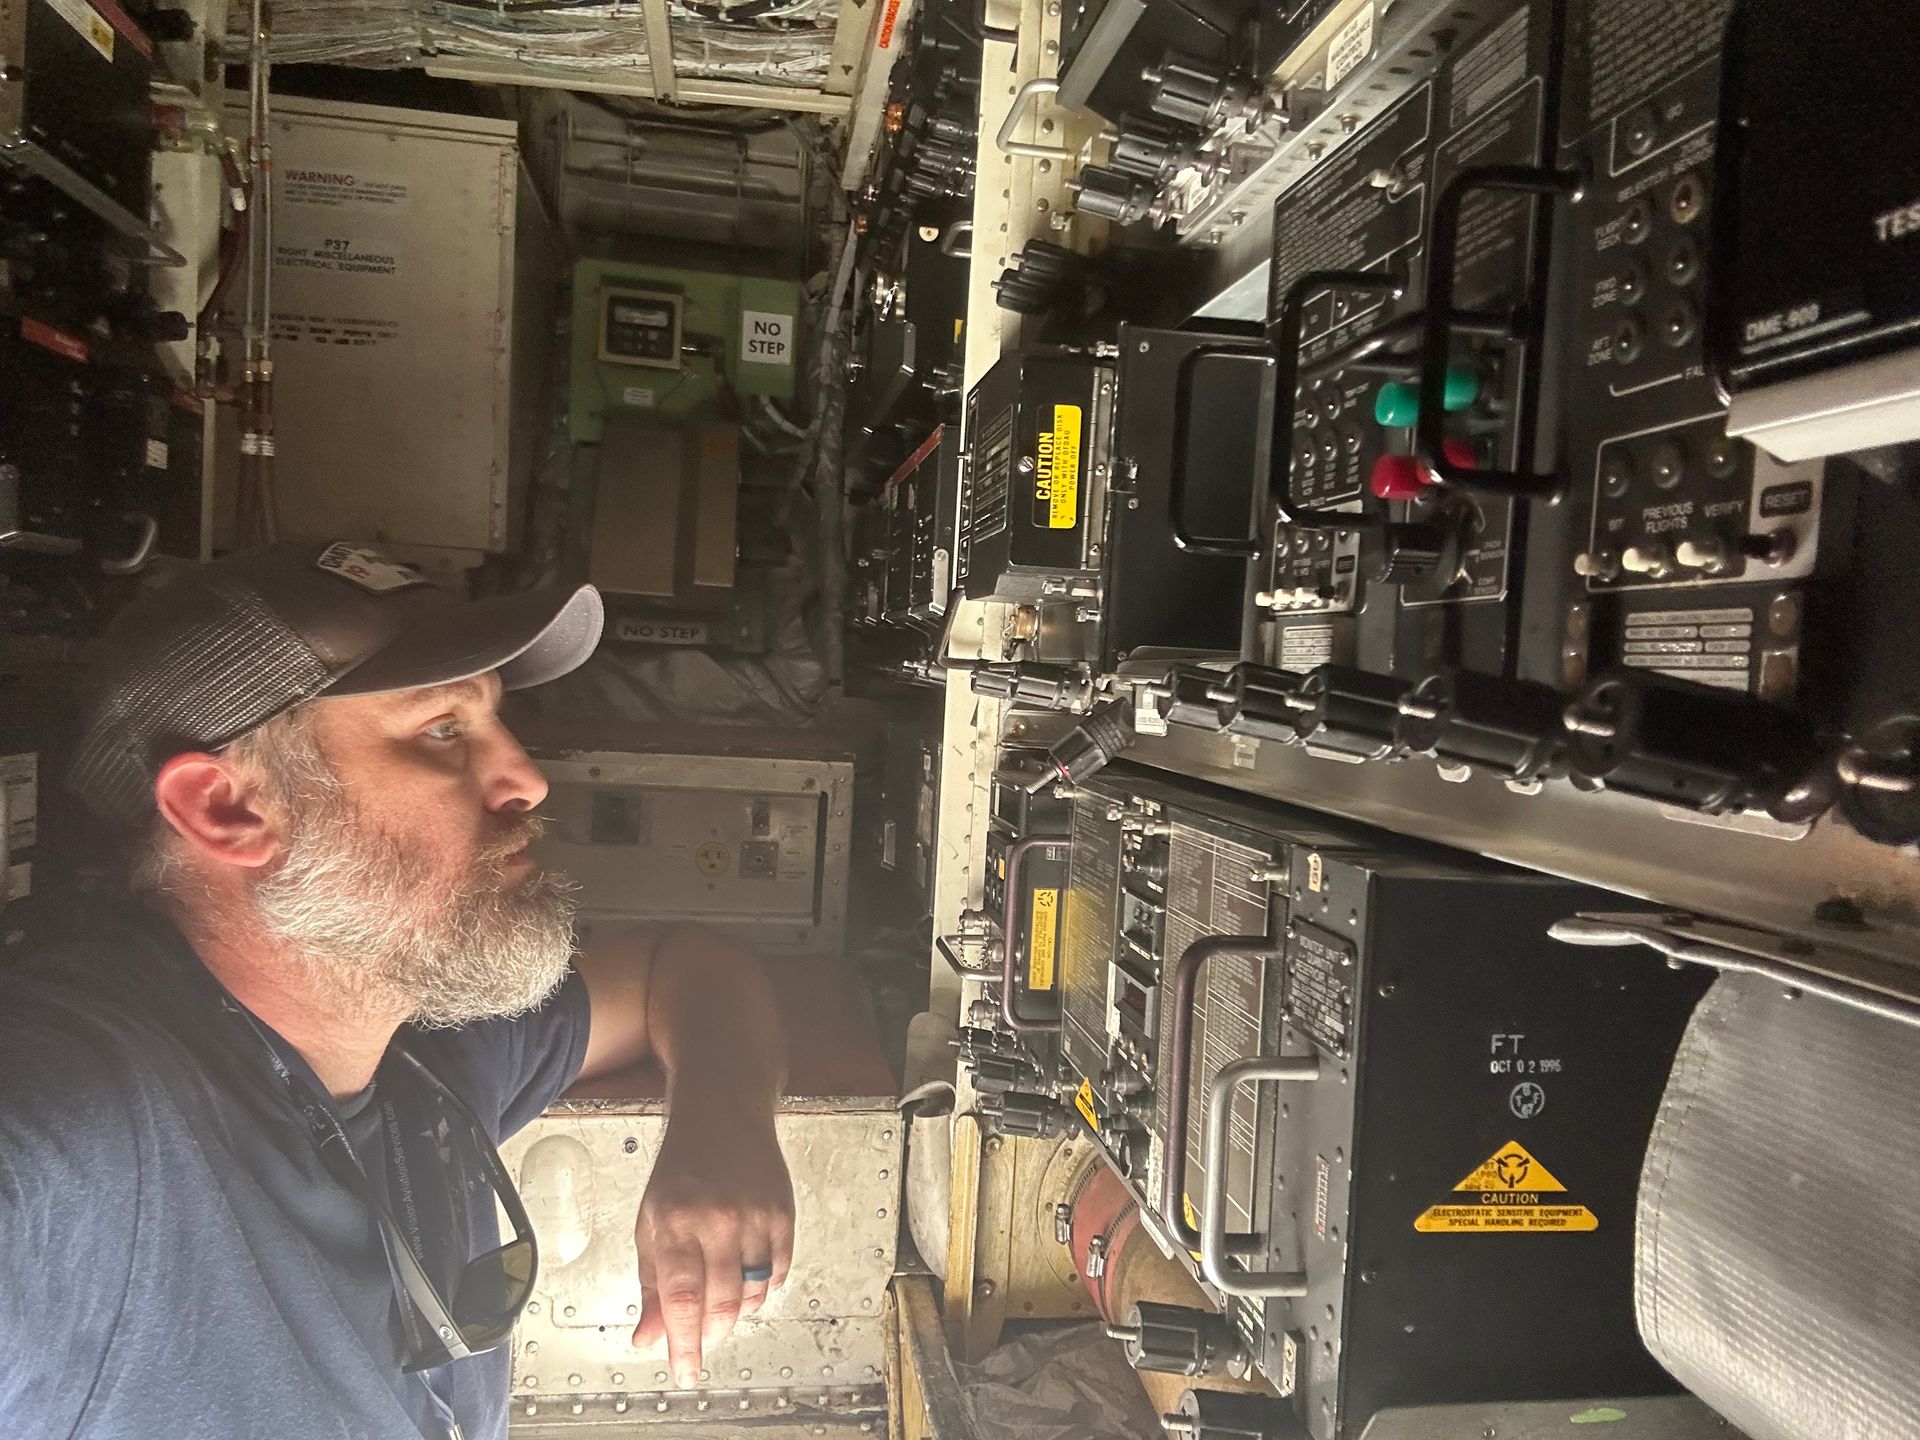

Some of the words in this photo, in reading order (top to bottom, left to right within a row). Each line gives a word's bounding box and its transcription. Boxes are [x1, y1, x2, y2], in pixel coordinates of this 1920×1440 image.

[284, 170, 354, 186] WARNING
[324, 239, 350, 250] P37
[278, 247, 308, 259] RIGHT
[314, 251, 395, 265] MISCELLANEOUS
[339, 262, 396, 275] EQUIPMENT
[754, 320, 781, 336] NO
[749, 340, 786, 355] STEP
[1054, 436, 1062, 470] REPLACE
[1035, 432, 1054, 500] CAUTION
[1052, 489, 1060, 518] REMOVE
[624, 625, 654, 637] NO
[660, 626, 699, 639] STEP
[1491, 1034, 1525, 1054] FT
[1490, 1060, 1511, 1074] OCT
[383, 1100, 424, 1261] www.VisionAviationServices.com
[1481, 1193, 1539, 1204] CAUTION
[1433, 1208, 1492, 1217] ELECTROSTATIC
[1539, 1208, 1584, 1217] EQUIPMENT
[1449, 1219, 1480, 1227] SPECIAL
[1485, 1219, 1524, 1227] HANDLING
[1529, 1218, 1567, 1227] REQUIRED
